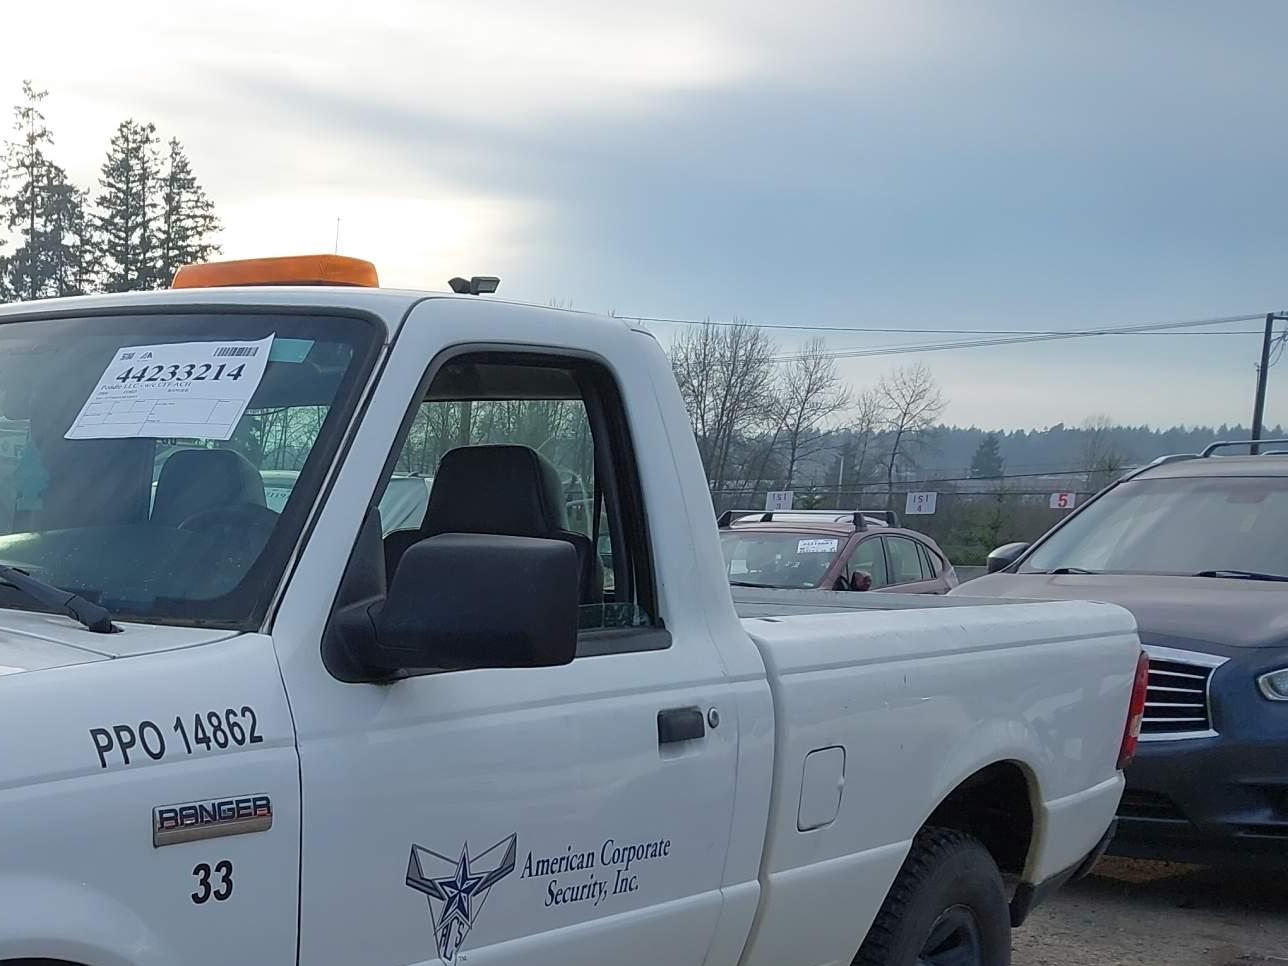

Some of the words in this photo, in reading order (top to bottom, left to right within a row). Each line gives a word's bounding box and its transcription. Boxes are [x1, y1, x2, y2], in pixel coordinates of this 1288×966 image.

[116, 363, 246, 383] 44233214
[1057, 493, 1069, 508] 5
[89, 720, 166, 768] PPO
[173, 706, 264, 754] 14862
[158, 796, 272, 832] RANGER
[520, 846, 594, 879] American
[600, 837, 671, 872] Corporate
[191, 860, 234, 905] 33
[544, 873, 608, 907] Security,
[612, 869, 639, 895] Inc.
